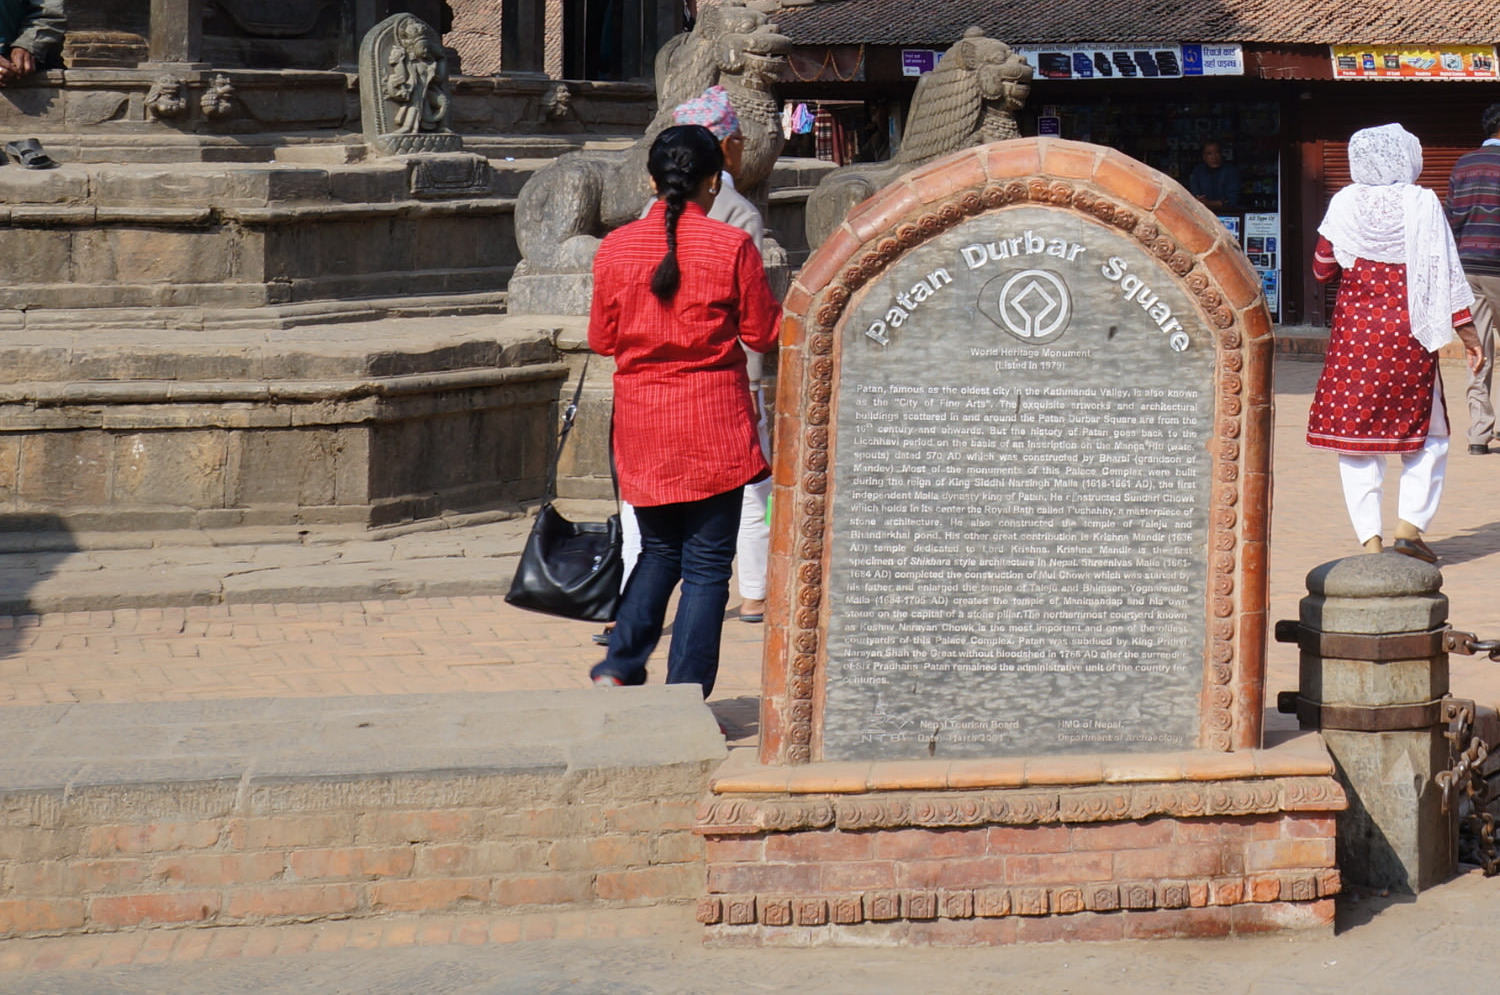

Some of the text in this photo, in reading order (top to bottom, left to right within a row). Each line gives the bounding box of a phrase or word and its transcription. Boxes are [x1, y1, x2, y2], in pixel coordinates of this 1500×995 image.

[865, 230, 1190, 352] Patan Durbar Square
[970, 348, 1091, 358] World Heritage Monument
[995, 361, 1023, 371] (Listed
[1029, 361, 1037, 370] in
[856, 384, 1198, 398] Patan, famous the oldest city the Kathmandu also known
[872, 396, 1198, 411] the Fine exquisite and architectural
[855, 410, 1197, 426] buildings scattered and around Patan Durbar Square from the
[877, 424, 1197, 439] century and But the history Patan goes back the
[903, 436, 1077, 451] period the basis inscription
[894, 450, 1078, 462] dated 570 which was constructed
[946, 464, 1196, 478] the monuments this Palace Complex were built
[853, 475, 1196, 489] during reign King Siddhi first
[852, 490, 1195, 503] independent dynasty king Chowk
[850, 503, 1181, 517] which holds center Royal Bath called masterpiece
[849, 516, 1116, 529] stone also constructed temple
[964, 530, 1164, 543] other great contribution Krishna Mandir
[874, 543, 1132, 555] temple dedicated Krishna Mandir
[909, 556, 1035, 568] Shikhara style architecture
[894, 568, 1177, 580] completed construction Chowk which started
[917, 582, 1013, 594] enlarged temple
[953, 595, 989, 605] created
[911, 609, 1188, 621] capital stone northernmost known
[942, 622, 1081, 634] Chowk most important
[913, 634, 1153, 648] this Palace Patan subdued King
[885, 648, 1122, 658] Shah Great without bloodshed after
[923, 661, 1170, 674] Patan remained administrative unit country
[920, 720, 1019, 730] Nepal Tourism Board
[1083, 720, 1092, 728] of
[1058, 733, 1183, 743] Department of Archaeology
